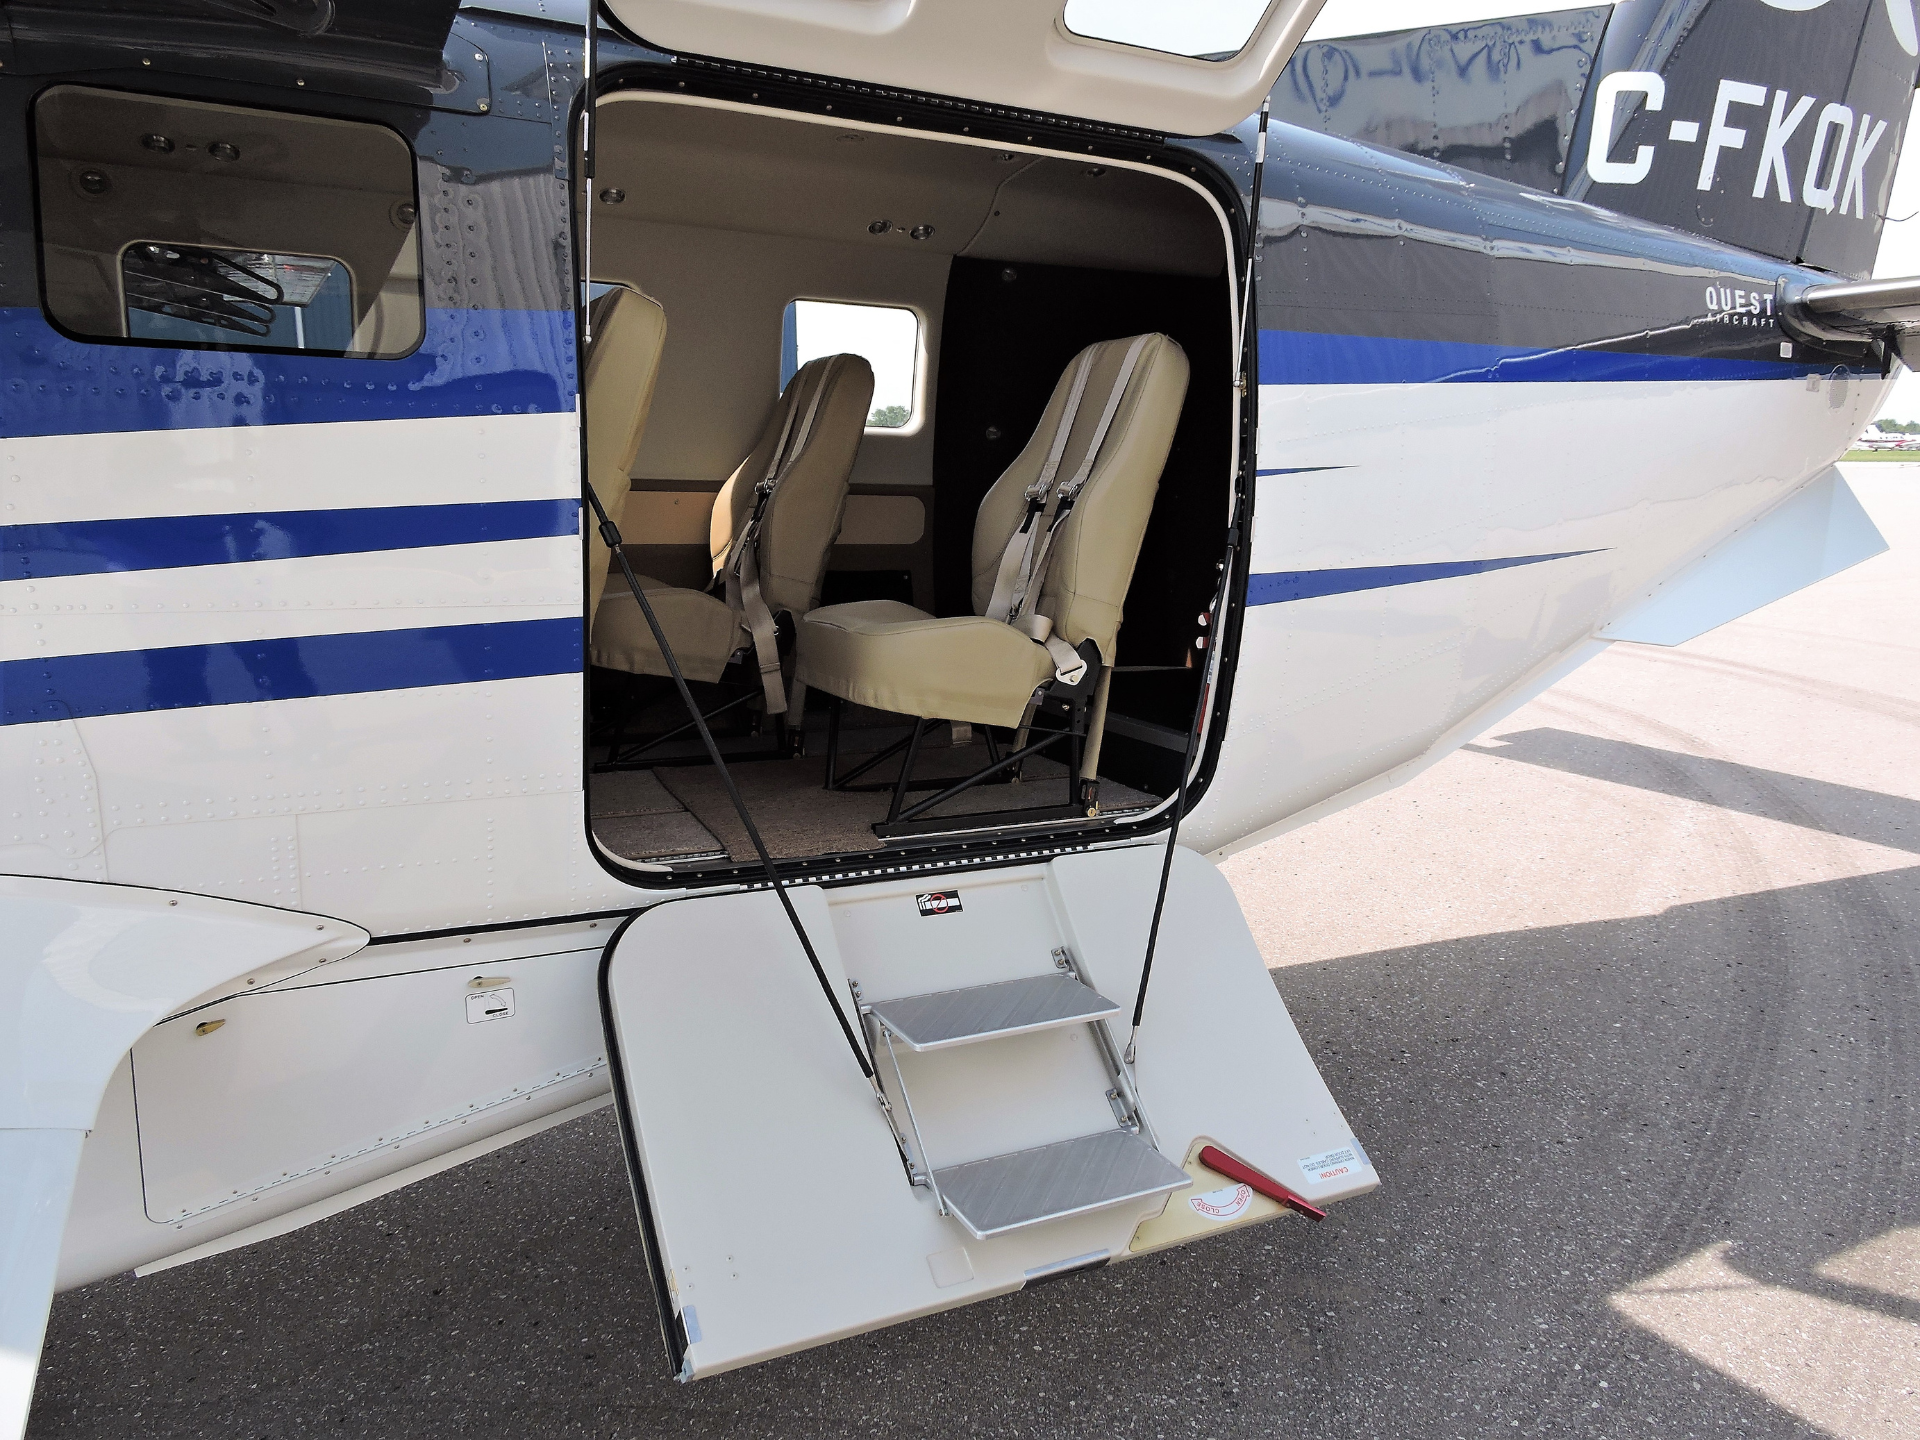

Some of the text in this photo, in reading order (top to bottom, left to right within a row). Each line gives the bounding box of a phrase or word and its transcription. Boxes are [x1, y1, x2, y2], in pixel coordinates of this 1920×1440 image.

[1587, 71, 1888, 219] C-FKQK
[1705, 286, 1774, 316] QUEST
[1707, 312, 1775, 328] AIRCRAFT
[1319, 1166, 1349, 1179] CAUTION!
[1235, 1189, 1246, 1206] OPEN
[1196, 1201, 1220, 1214] CLOSE
